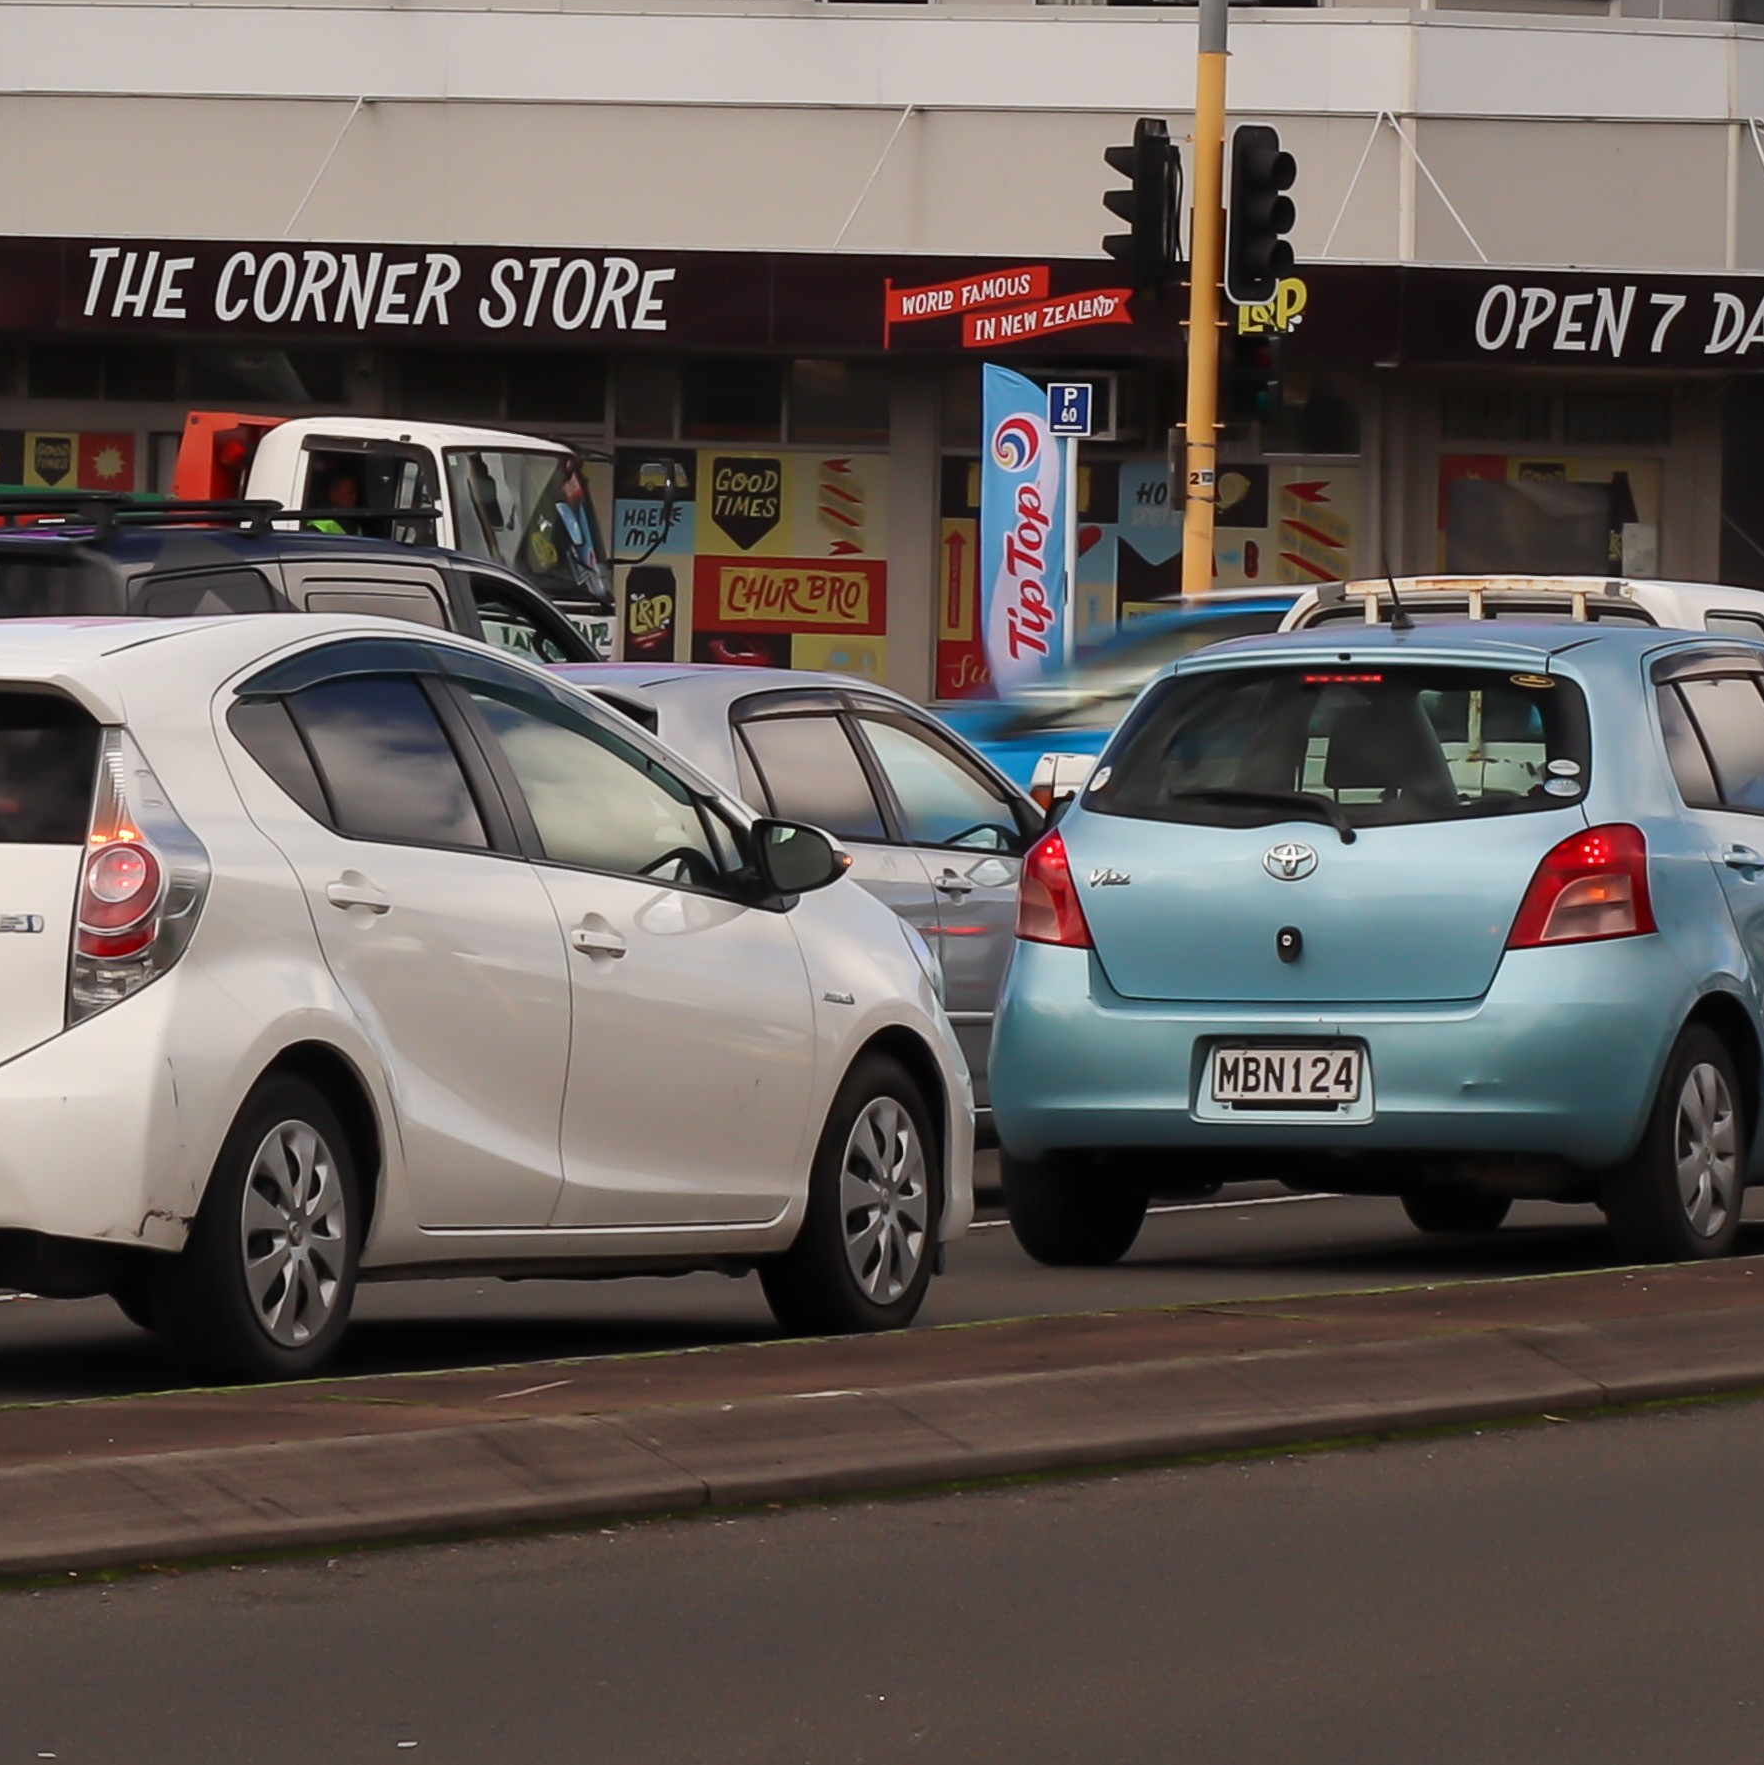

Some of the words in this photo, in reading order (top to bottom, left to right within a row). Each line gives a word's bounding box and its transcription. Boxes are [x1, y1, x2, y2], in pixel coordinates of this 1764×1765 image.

[83, 247, 195, 319] THE
[215, 250, 461, 330] CORNER
[479, 257, 676, 331] STORE
[902, 290, 955, 316] WORLD
[960, 273, 1032, 307] FAMOUS
[974, 317, 997, 341] IN
[1001, 310, 1038, 337] NEW
[1475, 284, 1637, 358] OPEN
[1650, 293, 1687, 353] 7
[1060, 407, 1078, 423] 60
[1064, 387, 1078, 406] P
[715, 467, 778, 493] GOOD
[715, 494, 778, 518] TIMES
[1005, 484, 1051, 577] Top
[725, 574, 818, 615] CHUR
[806, 574, 861, 620] BRO
[1006, 578, 1053, 662] Tip
[1218, 1055, 1354, 1095] MBN124
